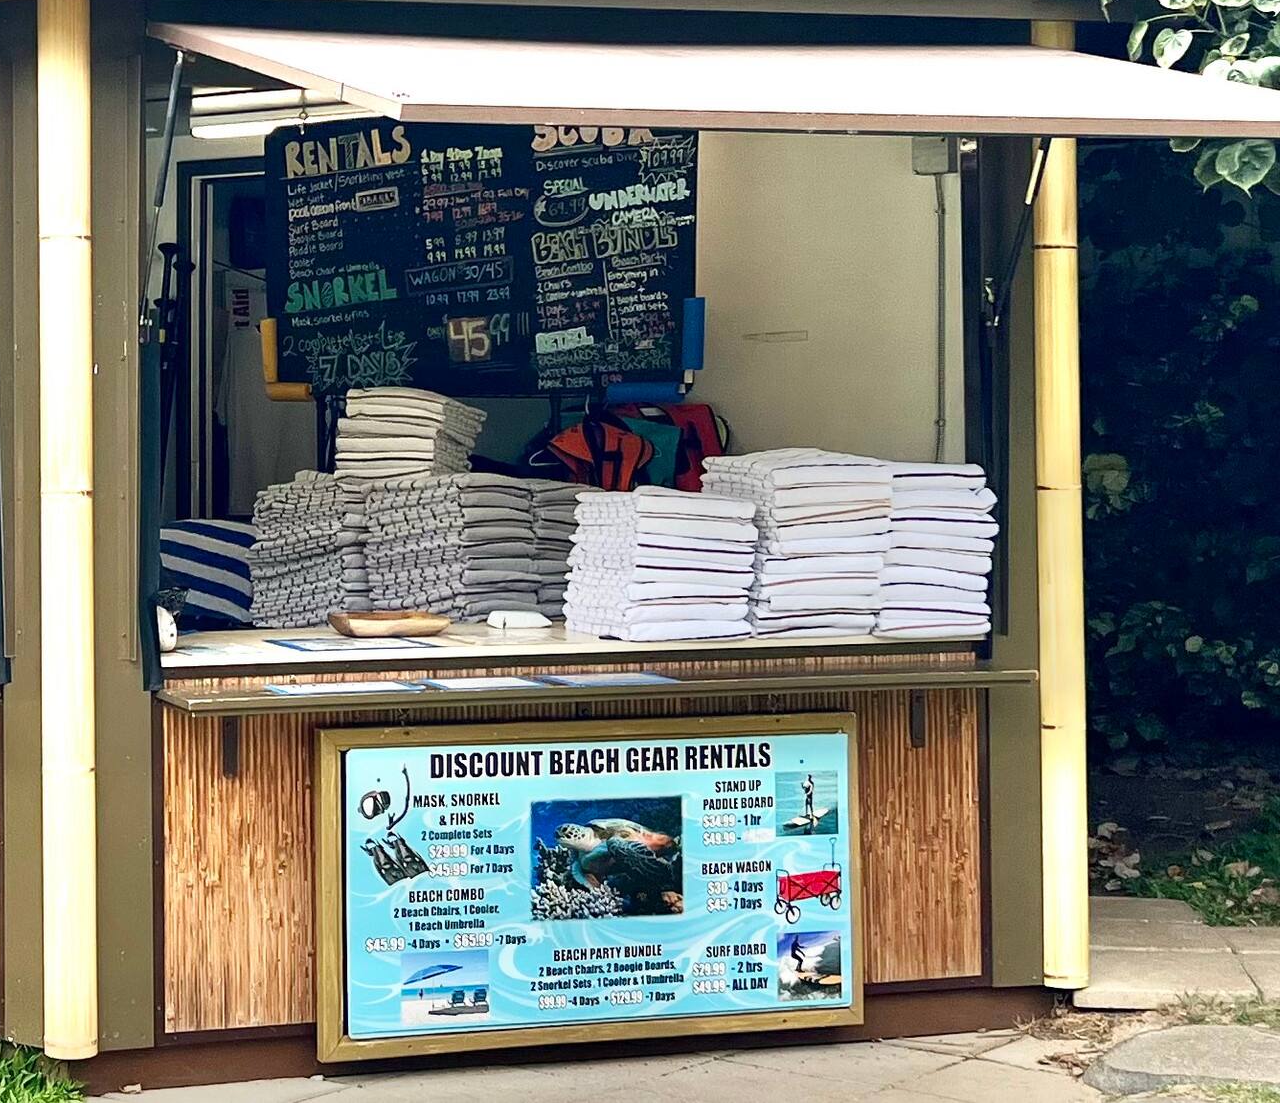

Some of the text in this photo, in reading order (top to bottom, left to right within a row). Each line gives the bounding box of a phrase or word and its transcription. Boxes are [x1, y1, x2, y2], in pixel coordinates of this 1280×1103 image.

[285, 125, 411, 178] RENTALS
[536, 156, 579, 171] Discover
[543, 176, 585, 196] SPECIAL
[589, 178, 691, 211] UNDERWATER
[311, 216, 338, 230] Board
[612, 207, 660, 226] CAMERA
[410, 267, 456, 286] WAGON
[285, 268, 397, 313] SNORKEL
[347, 351, 400, 379] DAYS
[430, 742, 771, 778] DISCOUNT BEACH GEAR RENTALS
[715, 780, 761, 792] STAND UP
[413, 793, 500, 808] MASK, SNORKEL
[703, 796, 773, 810] PADDLE BOARD
[439, 812, 474, 825] & FINS
[744, 814, 748, 825] 1
[750, 814, 761, 825] hr
[421, 829, 492, 841] 2 Complete Sets
[428, 844, 514, 859] $29.99 For 4 Days
[429, 863, 513, 878] $45.99 For 7 Days
[702, 860, 772, 875] BEACH WAGON
[707, 880, 763, 895] $30 4 Days
[409, 888, 484, 903] BEACH COMBO
[394, 908, 399, 918] 2
[401, 907, 429, 918] Beach
[707, 898, 762, 913] $45 7 Days
[415, 920, 442, 931] Beach
[444, 919, 485, 930] Umbrella
[366, 933, 527, 952] $45.99 Days $65.99 Days
[554, 944, 662, 962] BEACH PARTY BUNDLE
[706, 943, 766, 958] SURF BOARD
[539, 967, 544, 977] 2
[546, 965, 573, 976] Beach
[606, 963, 612, 973] 2
[614, 961, 642, 973] Boogie
[738, 962, 743, 973] 2
[746, 961, 762, 973] hrs
[530, 982, 536, 991] 2
[538, 980, 571, 991] Snorkel
[573, 979, 592, 989] Sets
[602, 977, 631, 987] Cooler
[632, 976, 638, 985] &
[646, 973, 684, 984] Umbrella
[732, 979, 748, 991] ALL
[750, 977, 768, 989] DAY
[539, 990, 675, 1010] $99.99 Days $129.99 Days
